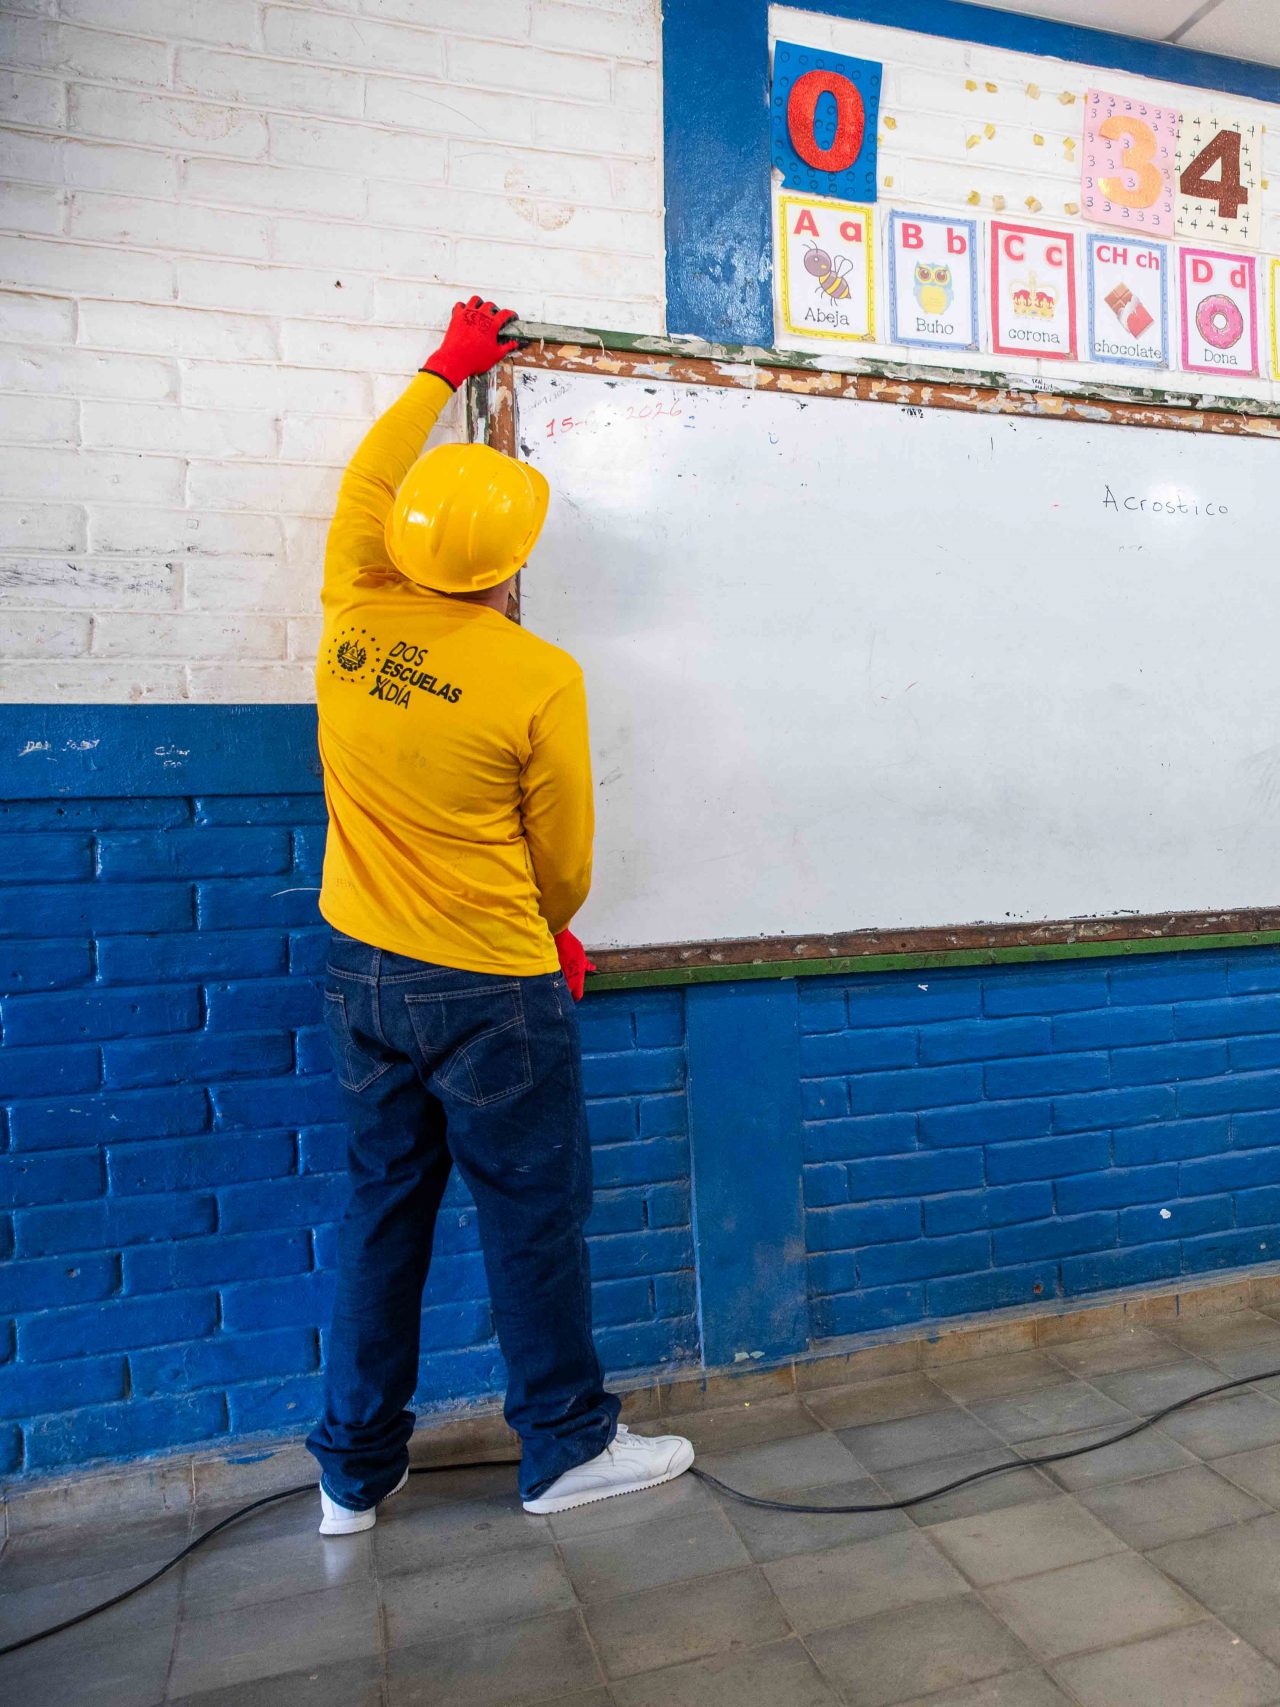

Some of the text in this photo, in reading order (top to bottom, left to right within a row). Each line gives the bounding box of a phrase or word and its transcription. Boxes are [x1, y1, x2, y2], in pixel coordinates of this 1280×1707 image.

[787, 70, 865, 172] 0
[1098, 115, 1163, 209] 3
[1180, 129, 1248, 219] 4
[792, 209, 862, 242] A a
[902, 222, 967, 255] B b
[1004, 234, 1063, 266] C c
[1096, 245, 1160, 270] CH ch
[1192, 258, 1246, 289] D d
[804, 307, 850, 327] Abeja
[916, 317, 954, 336] Buho
[1008, 327, 1060, 344] corona
[1094, 340, 1162, 359] chocolate
[1204, 349, 1238, 365] Dona
[626, 400, 682, 420] 2026
[1102, 484, 1229, 515] Acrostico
[389, 641, 428, 667] DOS
[380, 658, 463, 704] ESCUELAS
